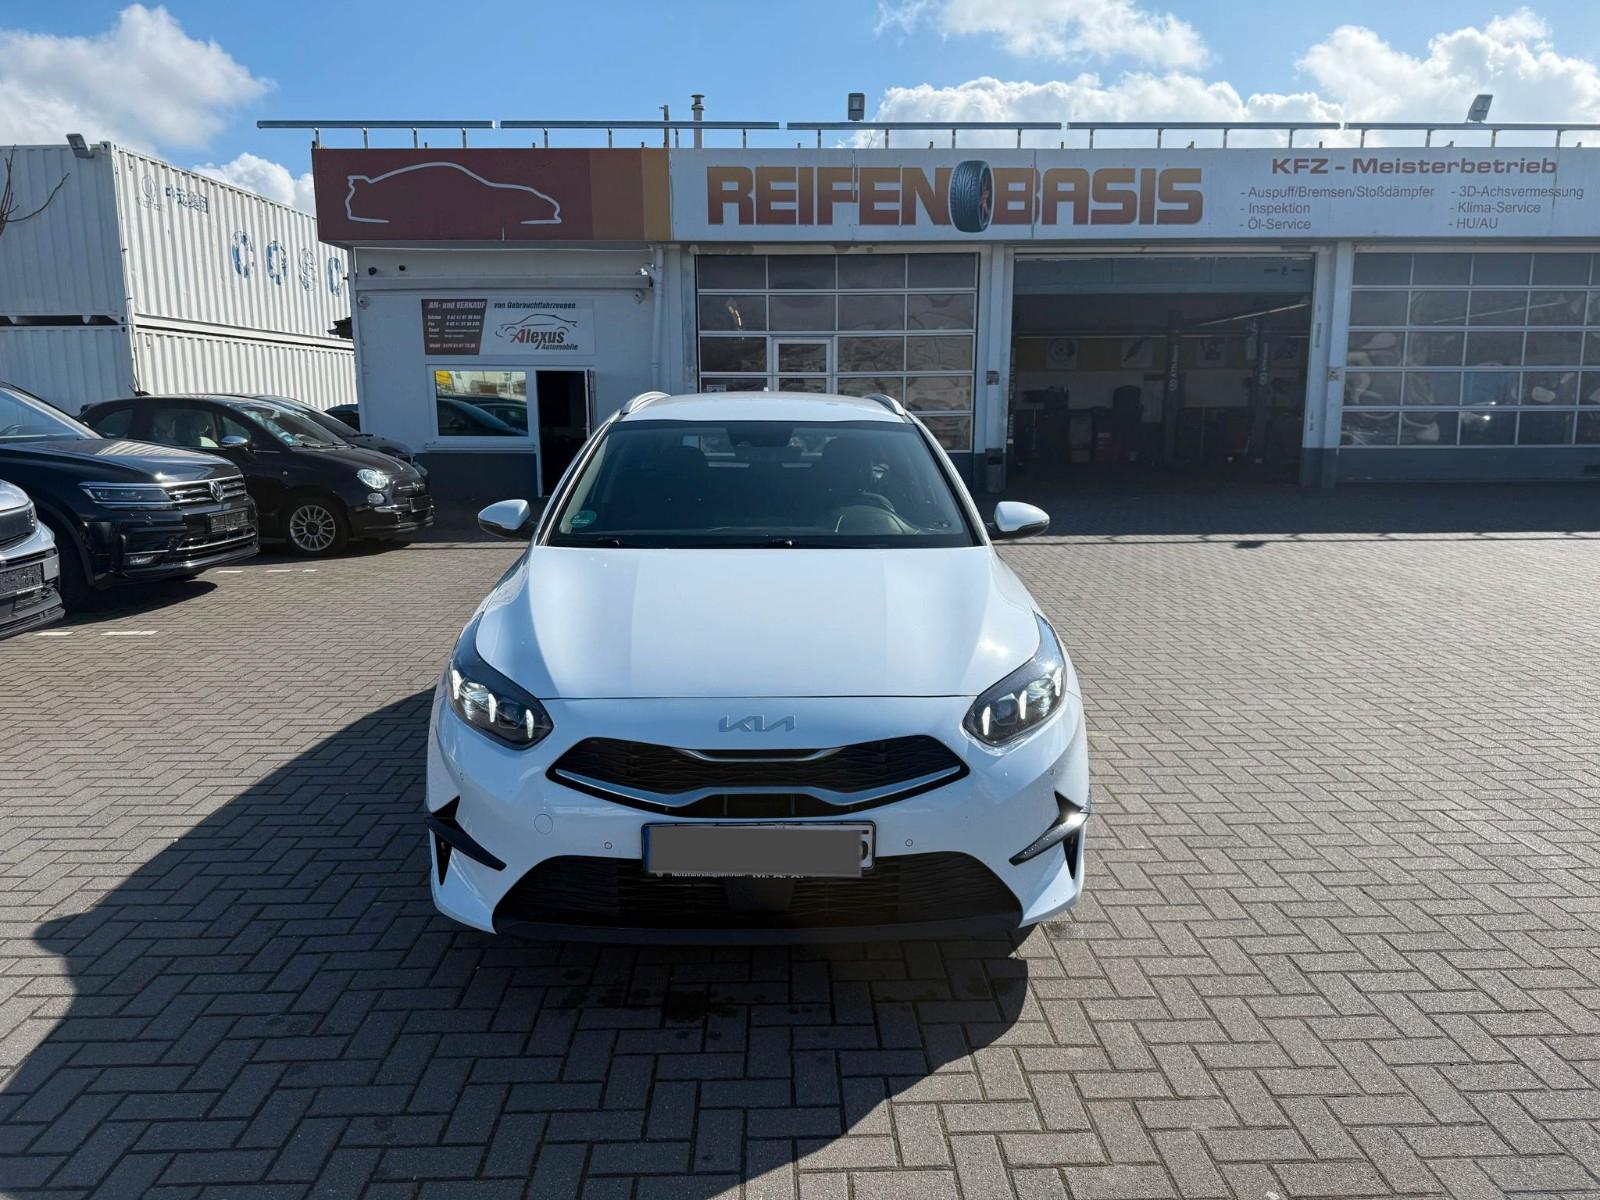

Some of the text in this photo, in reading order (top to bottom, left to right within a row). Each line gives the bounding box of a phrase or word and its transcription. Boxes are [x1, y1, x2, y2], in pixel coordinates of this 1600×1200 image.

[1272, 158, 1329, 174] KFZ
[1352, 158, 1557, 174] Meisterbetrieb
[706, 166, 954, 226] REIFEN
[990, 167, 1204, 226] BASIS
[1248, 186, 1435, 200] Auspuff/Bremsen/Stoßdämpfer
[1459, 185, 1584, 200] 3D-Achsvermessung
[1249, 203, 1311, 216] Inspektion
[1458, 202, 1541, 214] Klima-Service
[1248, 217, 1311, 230] Öl-Service
[1456, 218, 1498, 230] HU/AU
[456, 301, 486, 309] VERKAUF
[510, 326, 565, 350] Alexus
[541, 343, 578, 351] Automobile
